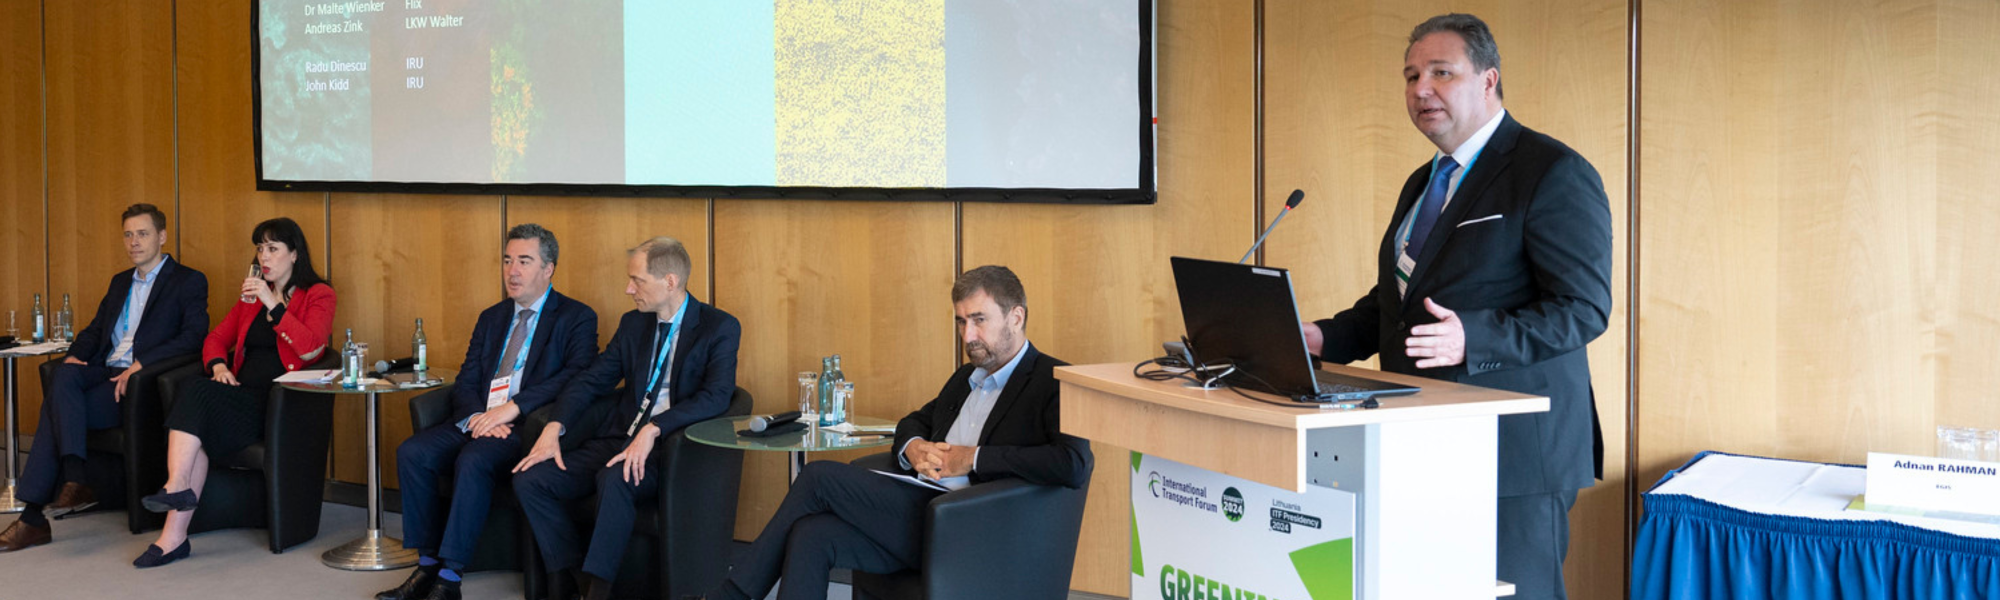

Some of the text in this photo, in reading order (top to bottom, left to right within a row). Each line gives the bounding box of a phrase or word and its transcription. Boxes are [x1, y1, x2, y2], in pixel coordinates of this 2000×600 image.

[304, 0, 385, 16] Dr Malte Wienker
[405, 0, 422, 9] Flix
[304, 20, 363, 34] Andreas Zink
[405, 14, 464, 29] LKW Walter
[305, 59, 367, 73] Radu Dinescu
[406, 57, 424, 69] IRU
[305, 78, 349, 92] John Kidd
[406, 76, 424, 89] IRU
[1893, 460, 1997, 476] Adnan RAHMAN
[1162, 475, 1207, 498] International
[1162, 487, 1194, 507] Transport
[1195, 497, 1218, 513] Forum
[1272, 499, 1301, 511] Lithuania
[1223, 501, 1243, 515] 2024
[1272, 509, 1319, 529] ITF Presidency
[1272, 521, 1289, 532] 2024
